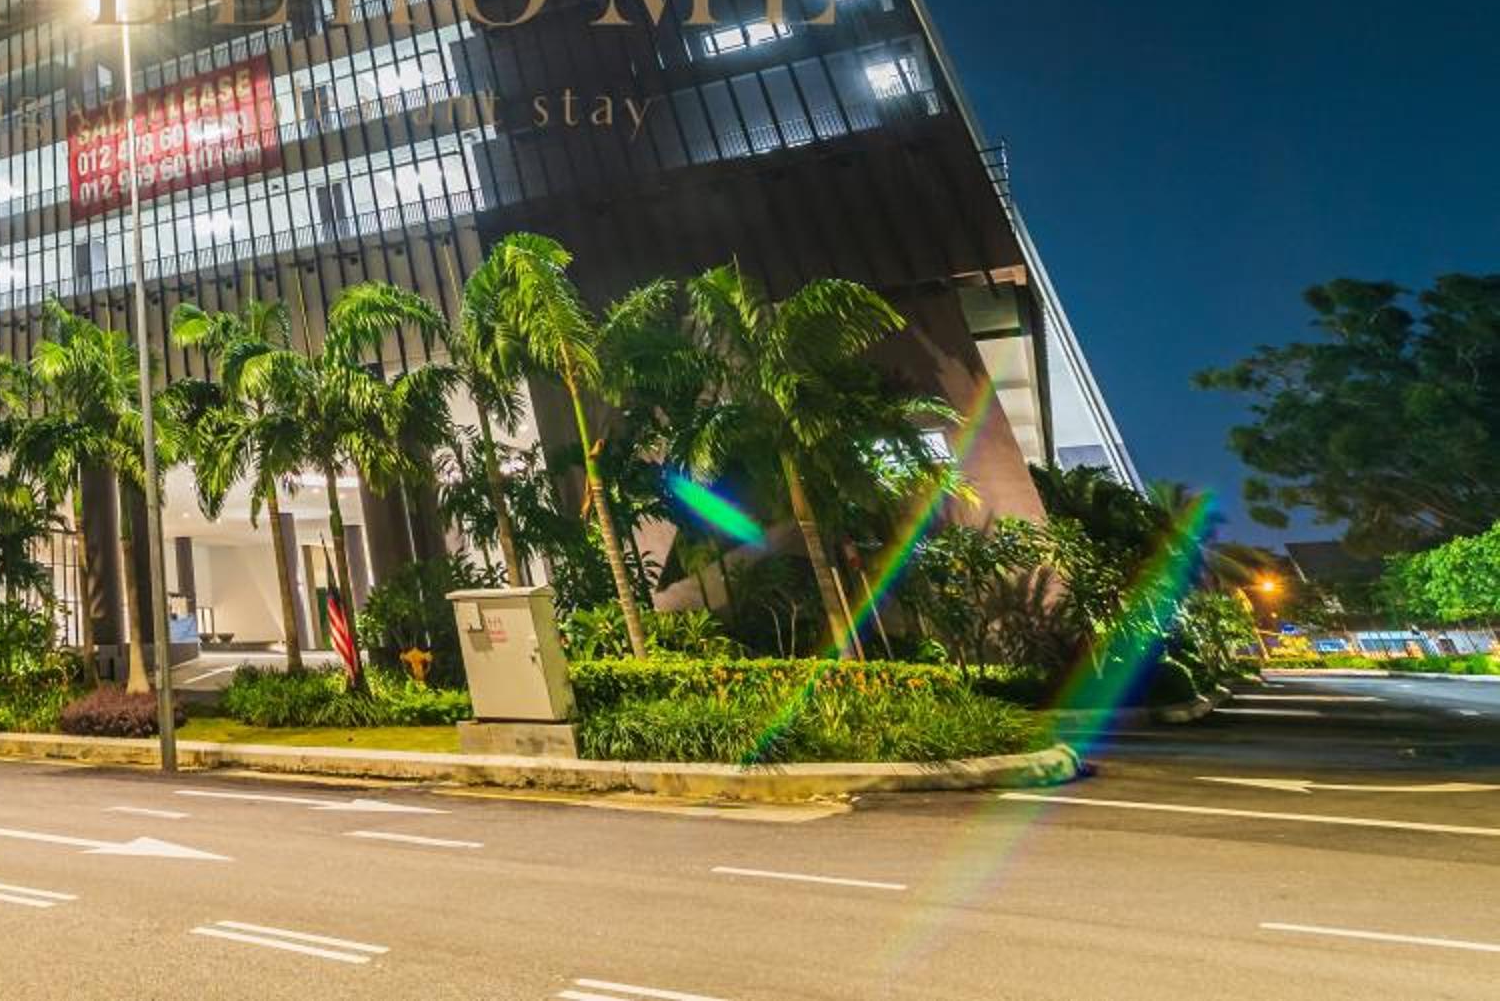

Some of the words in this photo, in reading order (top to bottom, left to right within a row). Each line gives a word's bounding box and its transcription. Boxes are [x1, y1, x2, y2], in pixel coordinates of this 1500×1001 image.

[164, 69, 250, 121] LEASE
[77, 141, 112, 177] 012
[80, 173, 114, 207] 012
